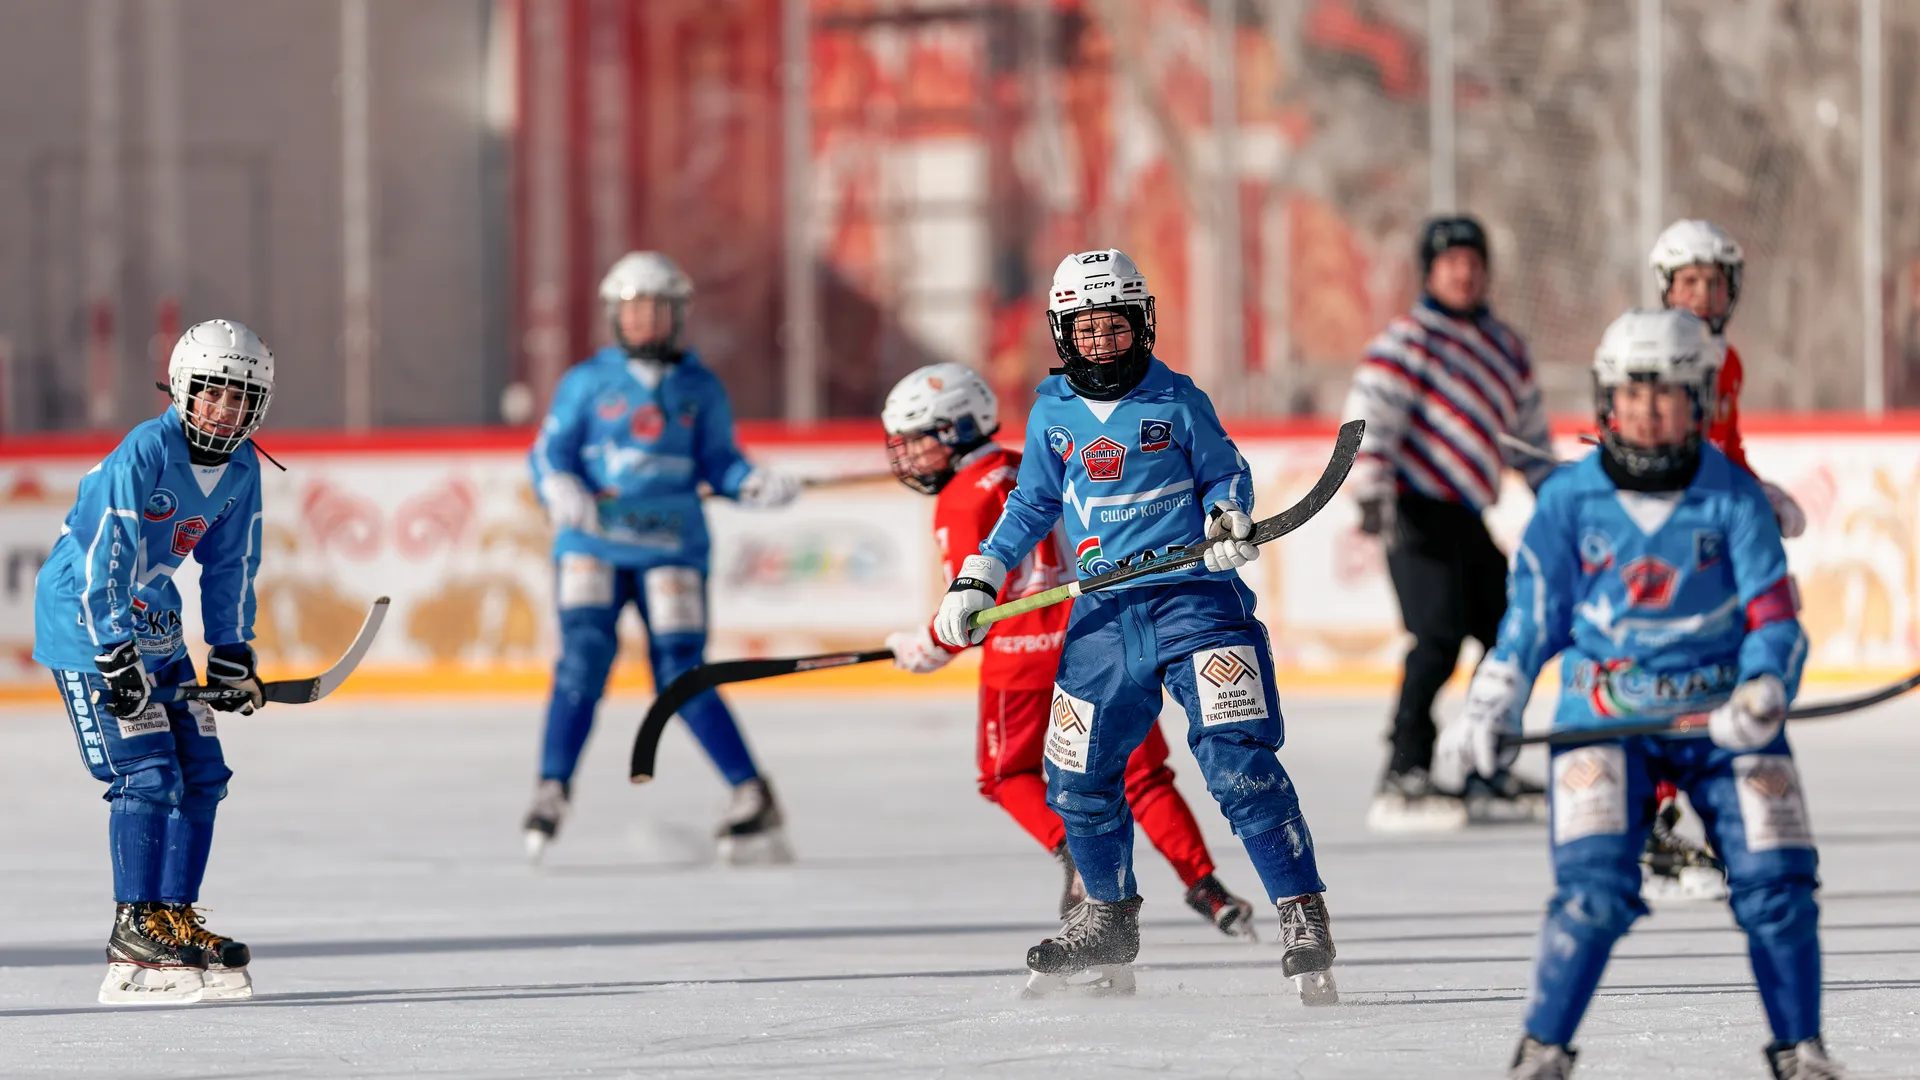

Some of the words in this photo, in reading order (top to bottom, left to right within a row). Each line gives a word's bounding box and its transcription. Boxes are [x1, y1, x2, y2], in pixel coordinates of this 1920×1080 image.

[1081, 253, 1110, 265] 28
[1083, 280, 1116, 291] CCM
[218, 352, 258, 365] JOFA
[1085, 449, 1121, 459] ВЫМПЕЛ
[1100, 507, 1137, 523] СШОР
[1140, 492, 1193, 517] КОРОЛЁВ
[956, 578, 973, 586] PRO
[1217, 691, 1227, 700] АО
[1228, 689, 1248, 698] КШФ
